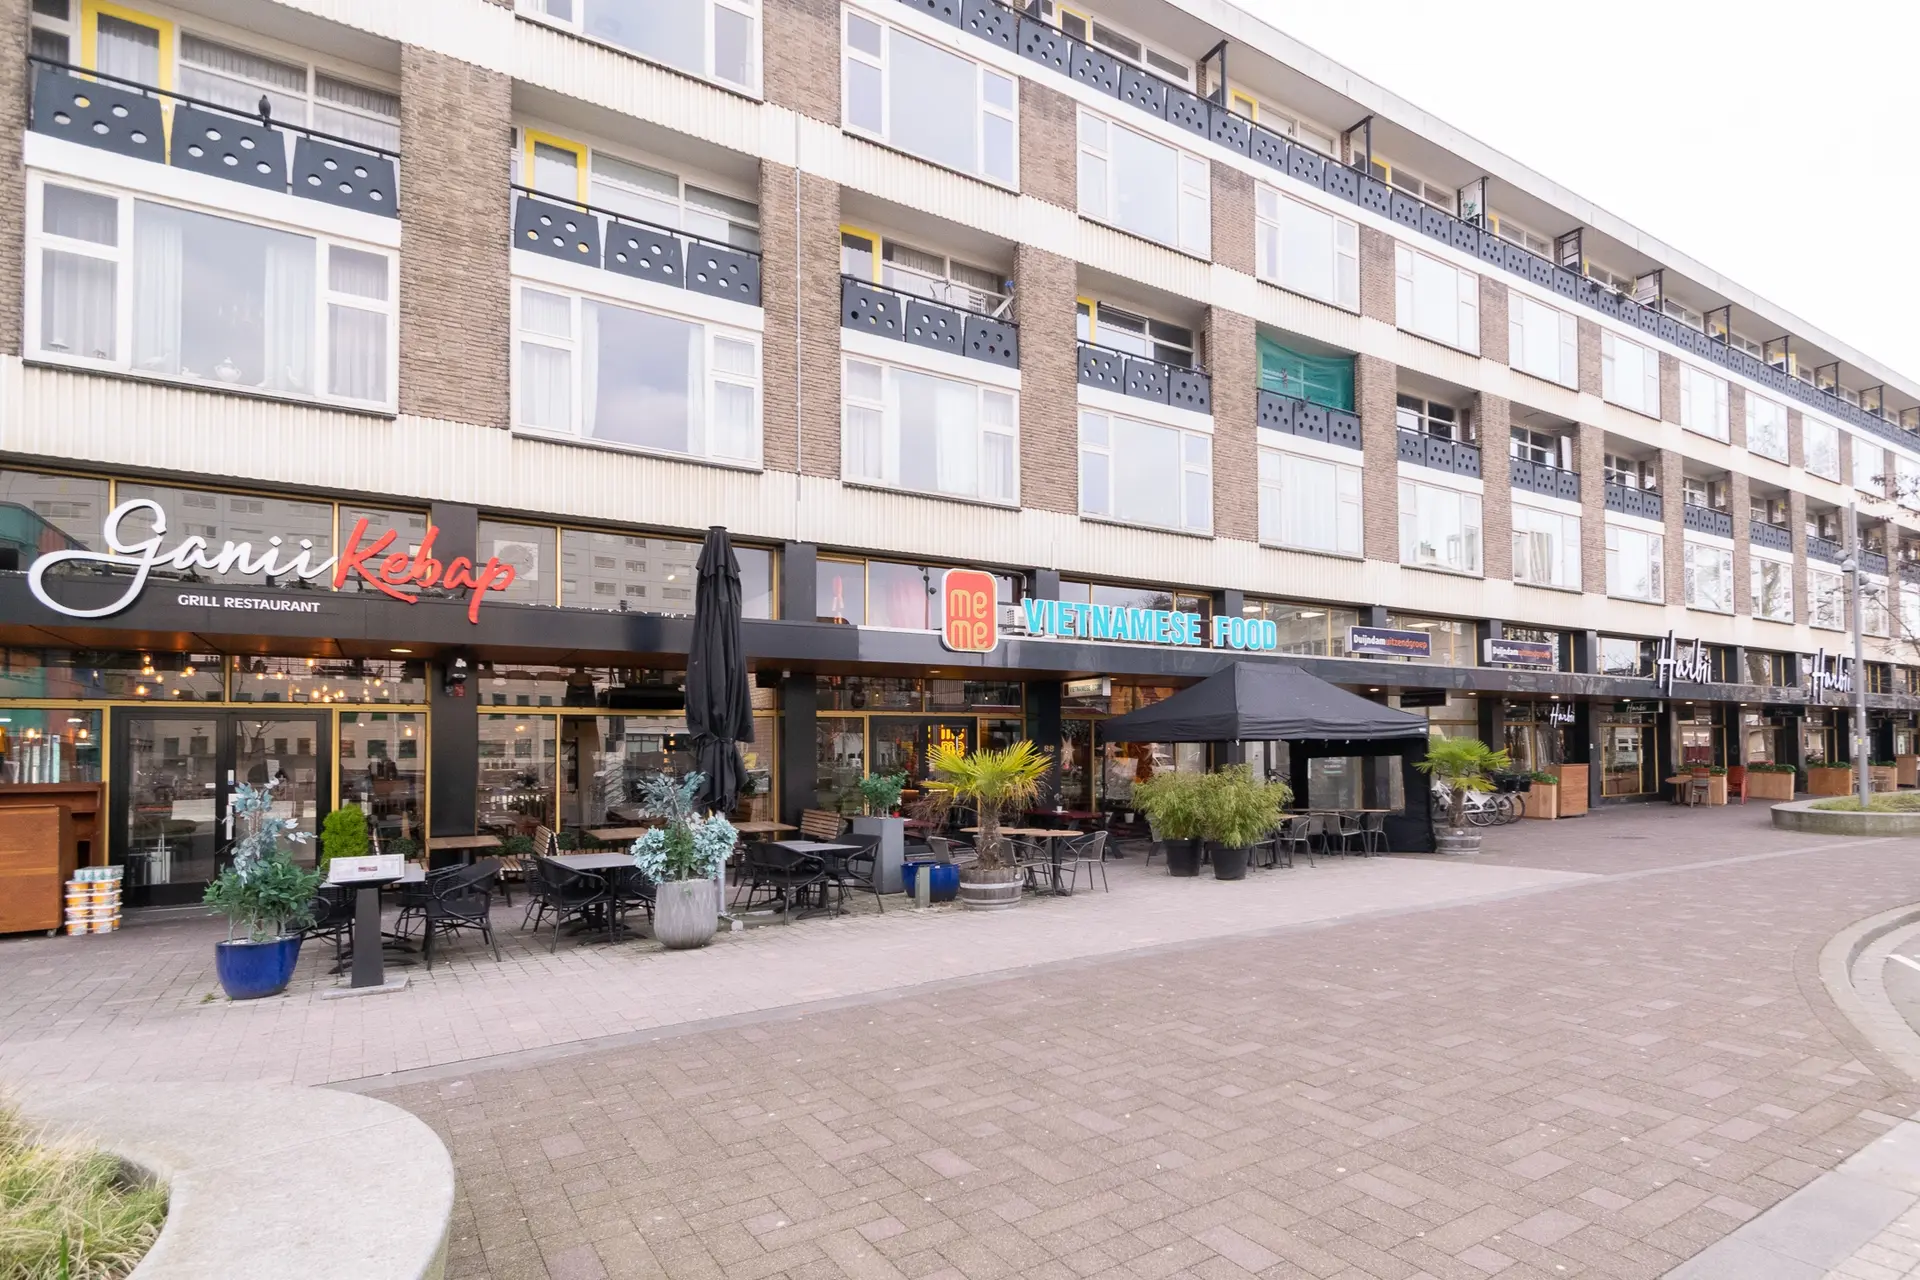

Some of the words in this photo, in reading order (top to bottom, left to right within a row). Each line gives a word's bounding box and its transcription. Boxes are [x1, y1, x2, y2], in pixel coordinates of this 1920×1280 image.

[28, 498, 338, 618] Ganii
[333, 517, 517, 624] Kebap
[178, 594, 220, 607] GRILL
[224, 597, 321, 613] RESTAURANT
[950, 589, 988, 619] me
[950, 620, 988, 650] me
[1021, 597, 1202, 646] VIETNAMESE
[1213, 615, 1278, 650] FOOD
